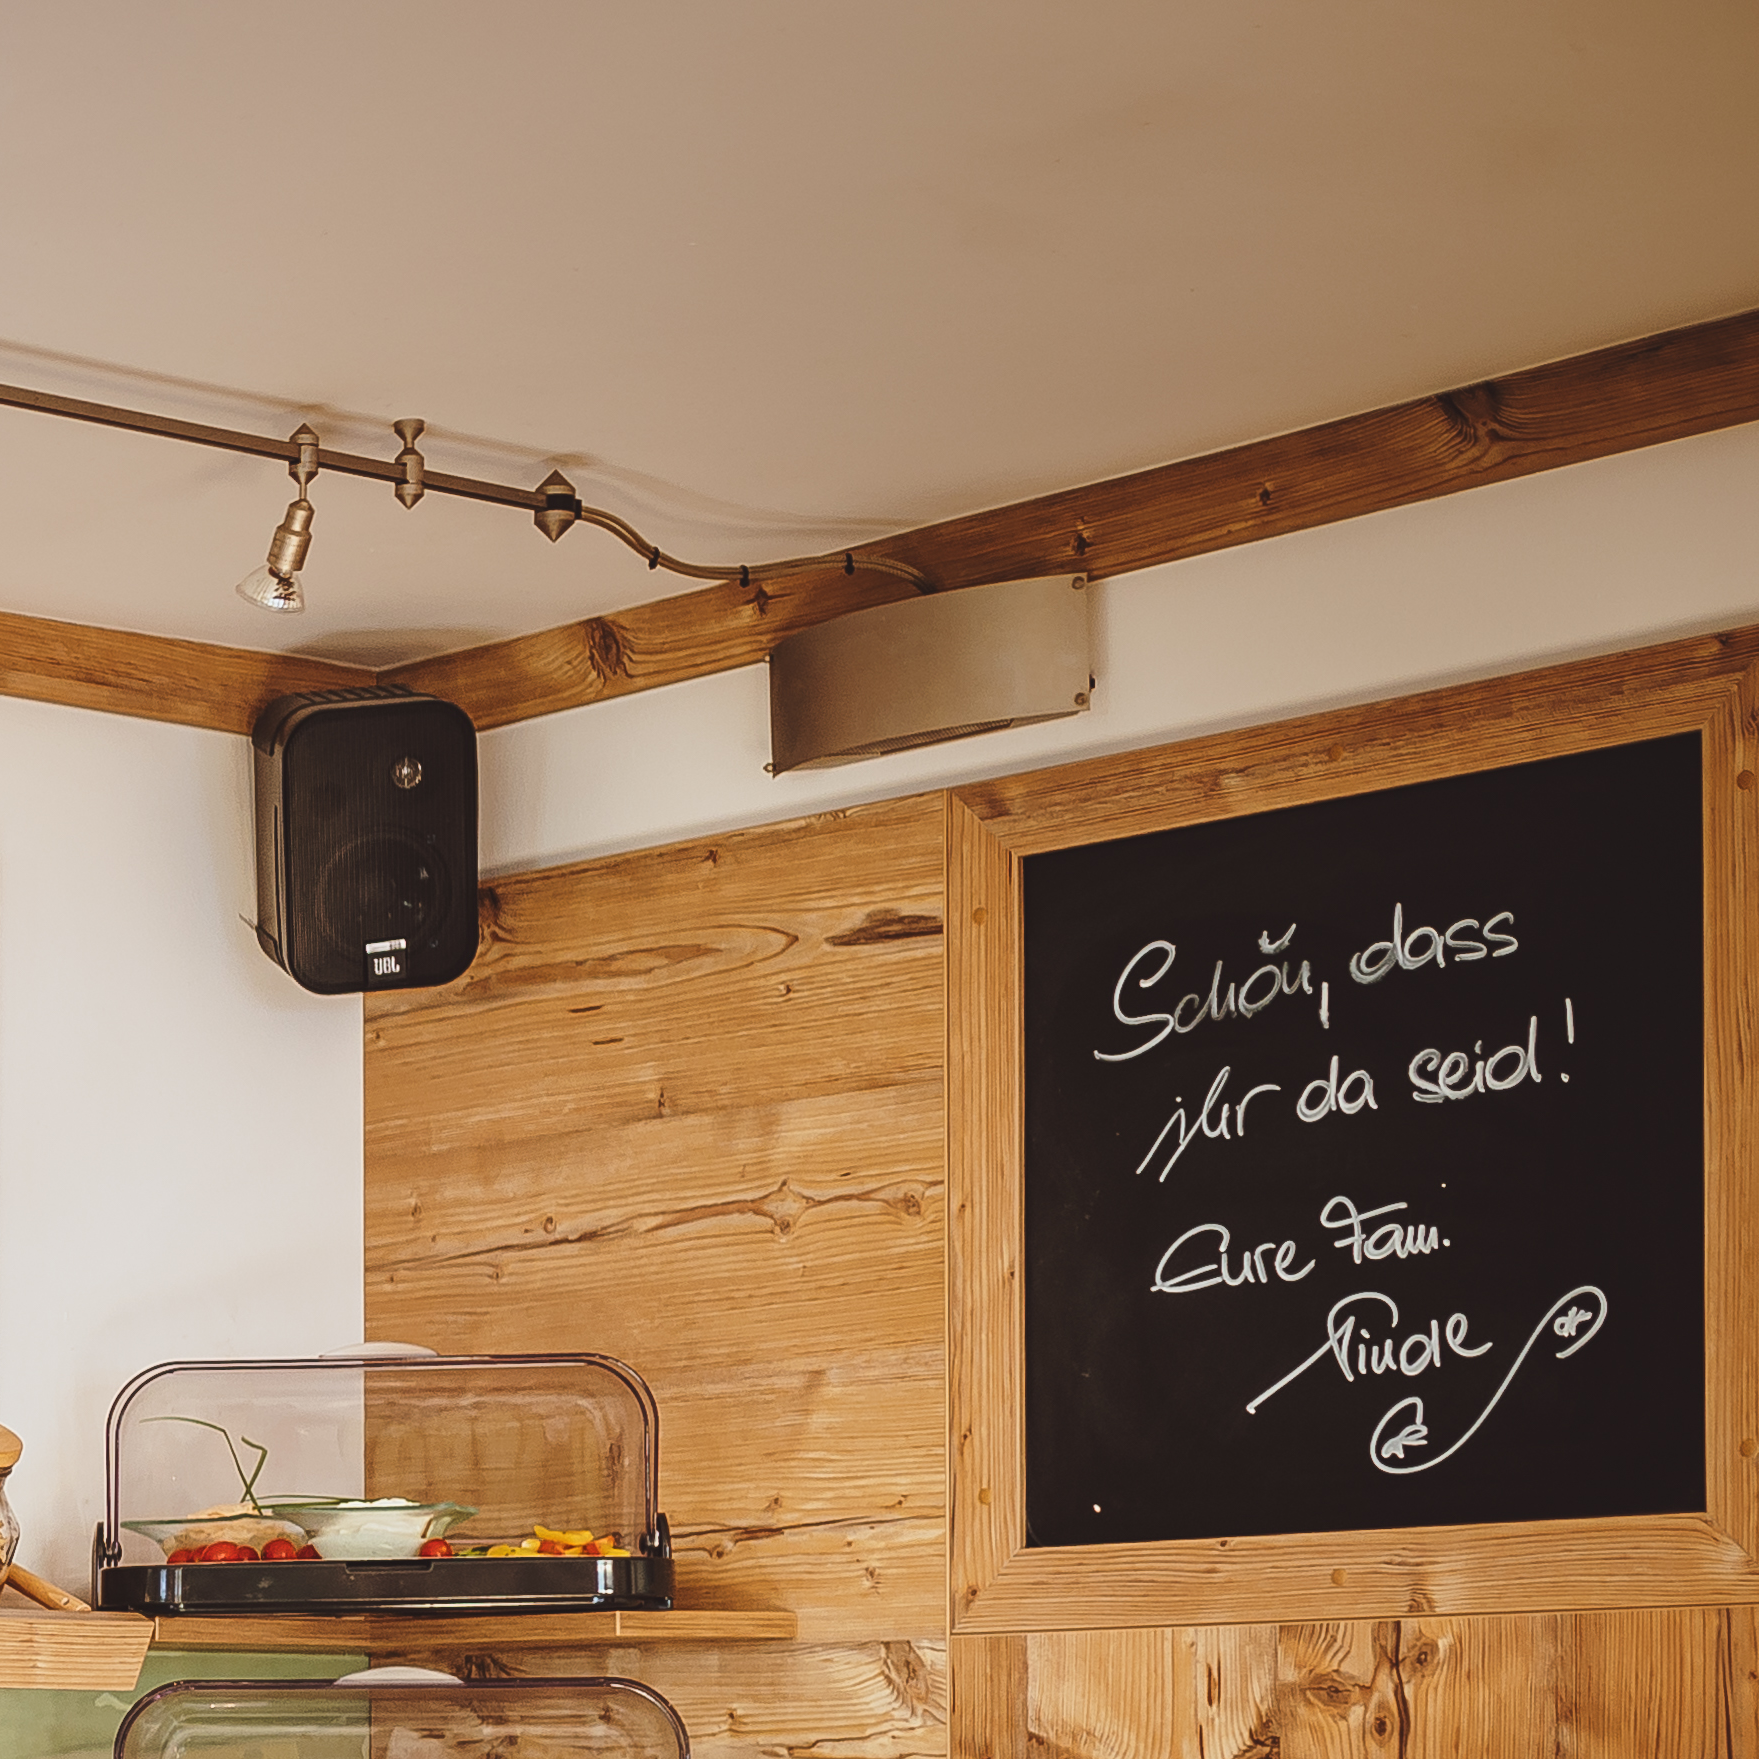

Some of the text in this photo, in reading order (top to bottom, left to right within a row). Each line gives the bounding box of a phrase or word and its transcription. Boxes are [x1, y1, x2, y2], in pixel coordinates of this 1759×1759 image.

[1094, 902, 1519, 1062] Schön, dass
[1295, 1055, 1379, 1124] da
[1408, 997, 1576, 1103] seid!
[1149, 1195, 1452, 1293] Eure Fam.
